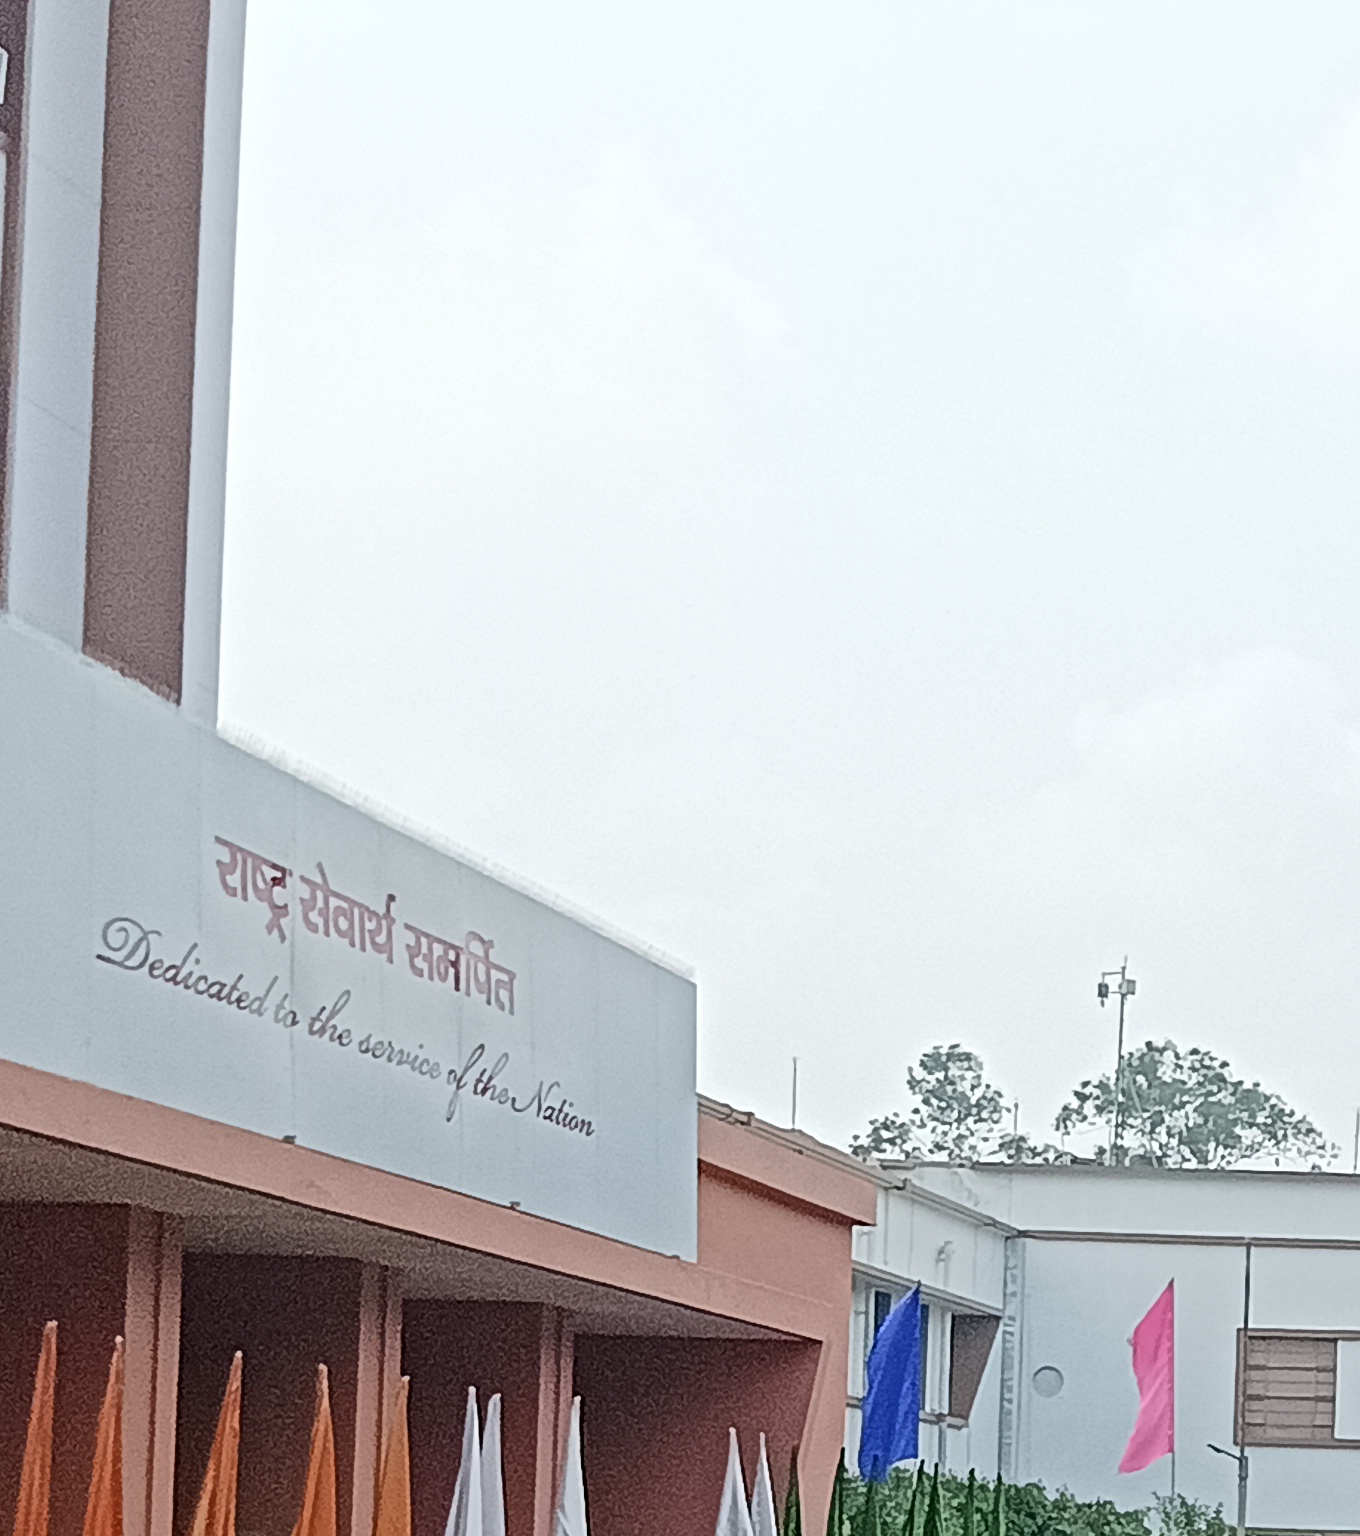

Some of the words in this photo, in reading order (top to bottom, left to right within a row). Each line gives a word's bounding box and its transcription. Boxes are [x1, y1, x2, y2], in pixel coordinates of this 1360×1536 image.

[215, 835, 293, 944] राष्ट्र
[299, 861, 396, 964] सेवार्थ
[403, 922, 517, 1016] समर्पित
[96, 917, 279, 1018] Dedicated
[273, 993, 300, 1029] to
[307, 989, 353, 1047] the
[358, 1034, 442, 1080] service
[446, 1043, 485, 1123] of
[472, 1052, 510, 1105] the
[510, 1080, 596, 1137] Nation
